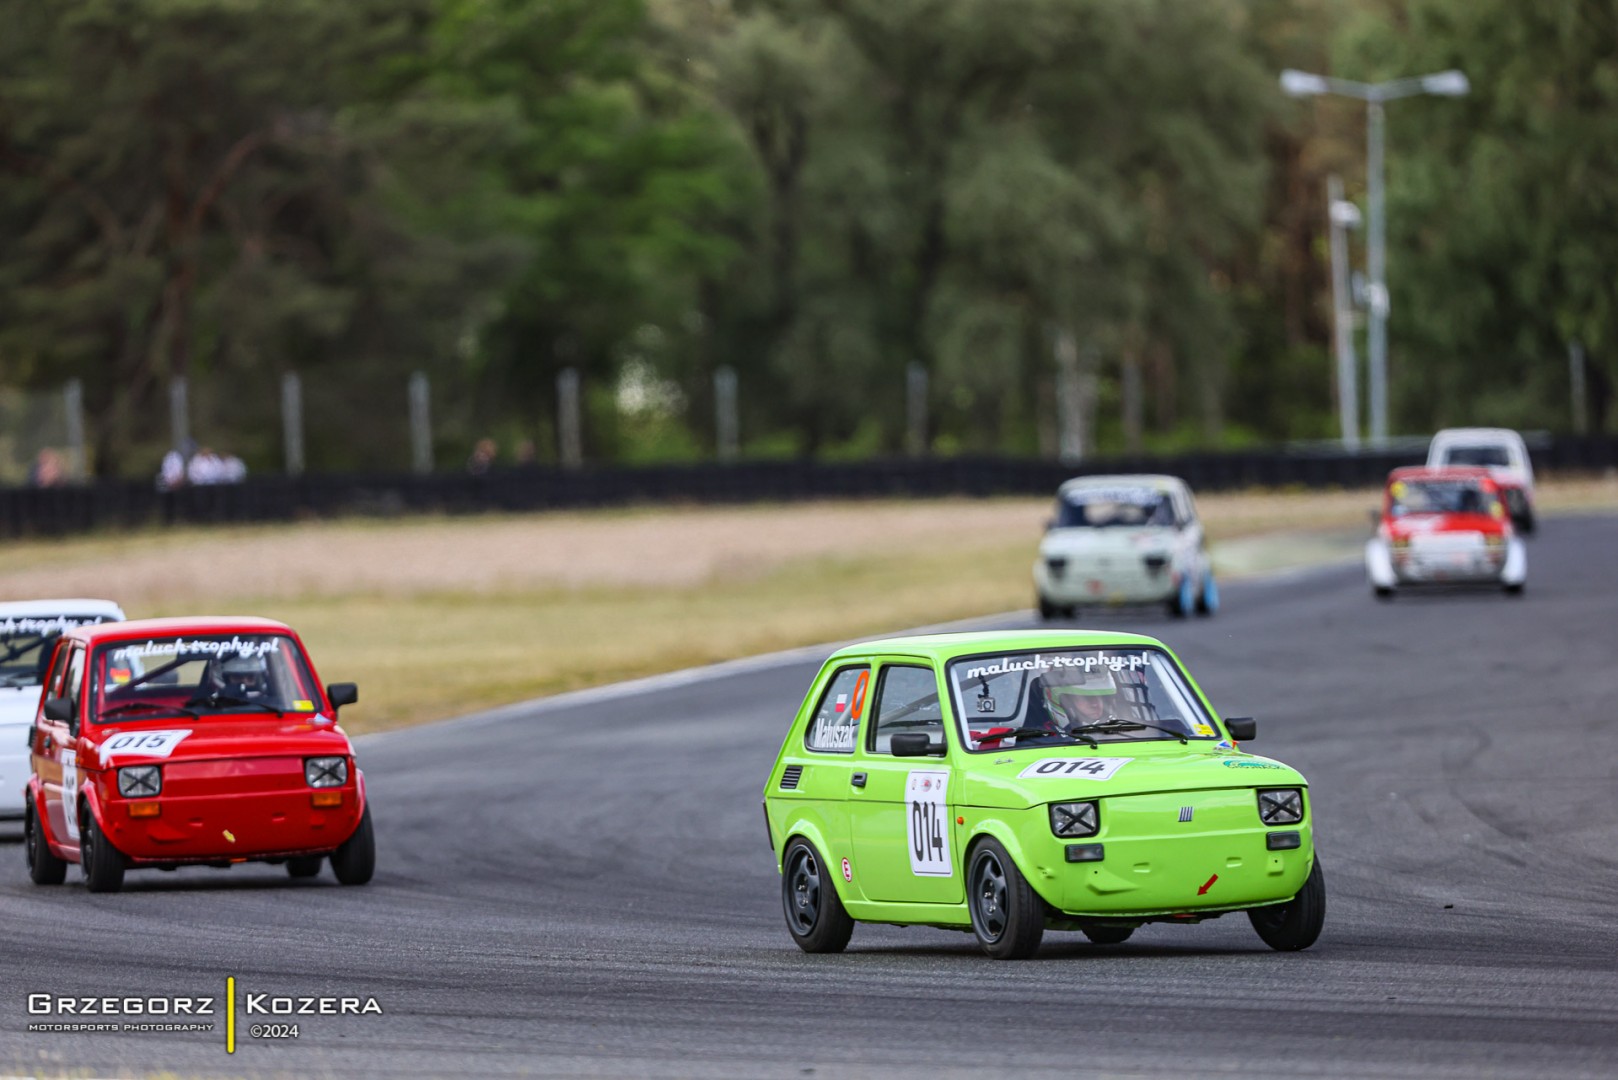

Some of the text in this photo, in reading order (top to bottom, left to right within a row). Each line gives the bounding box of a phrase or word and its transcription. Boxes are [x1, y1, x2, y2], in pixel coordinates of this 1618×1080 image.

[114, 636, 279, 661] maluch-trophy.pl
[967, 651, 1150, 679] maluch-trophy.pl
[110, 734, 171, 750] 015
[1036, 760, 1105, 775] 014
[912, 800, 943, 862] 014
